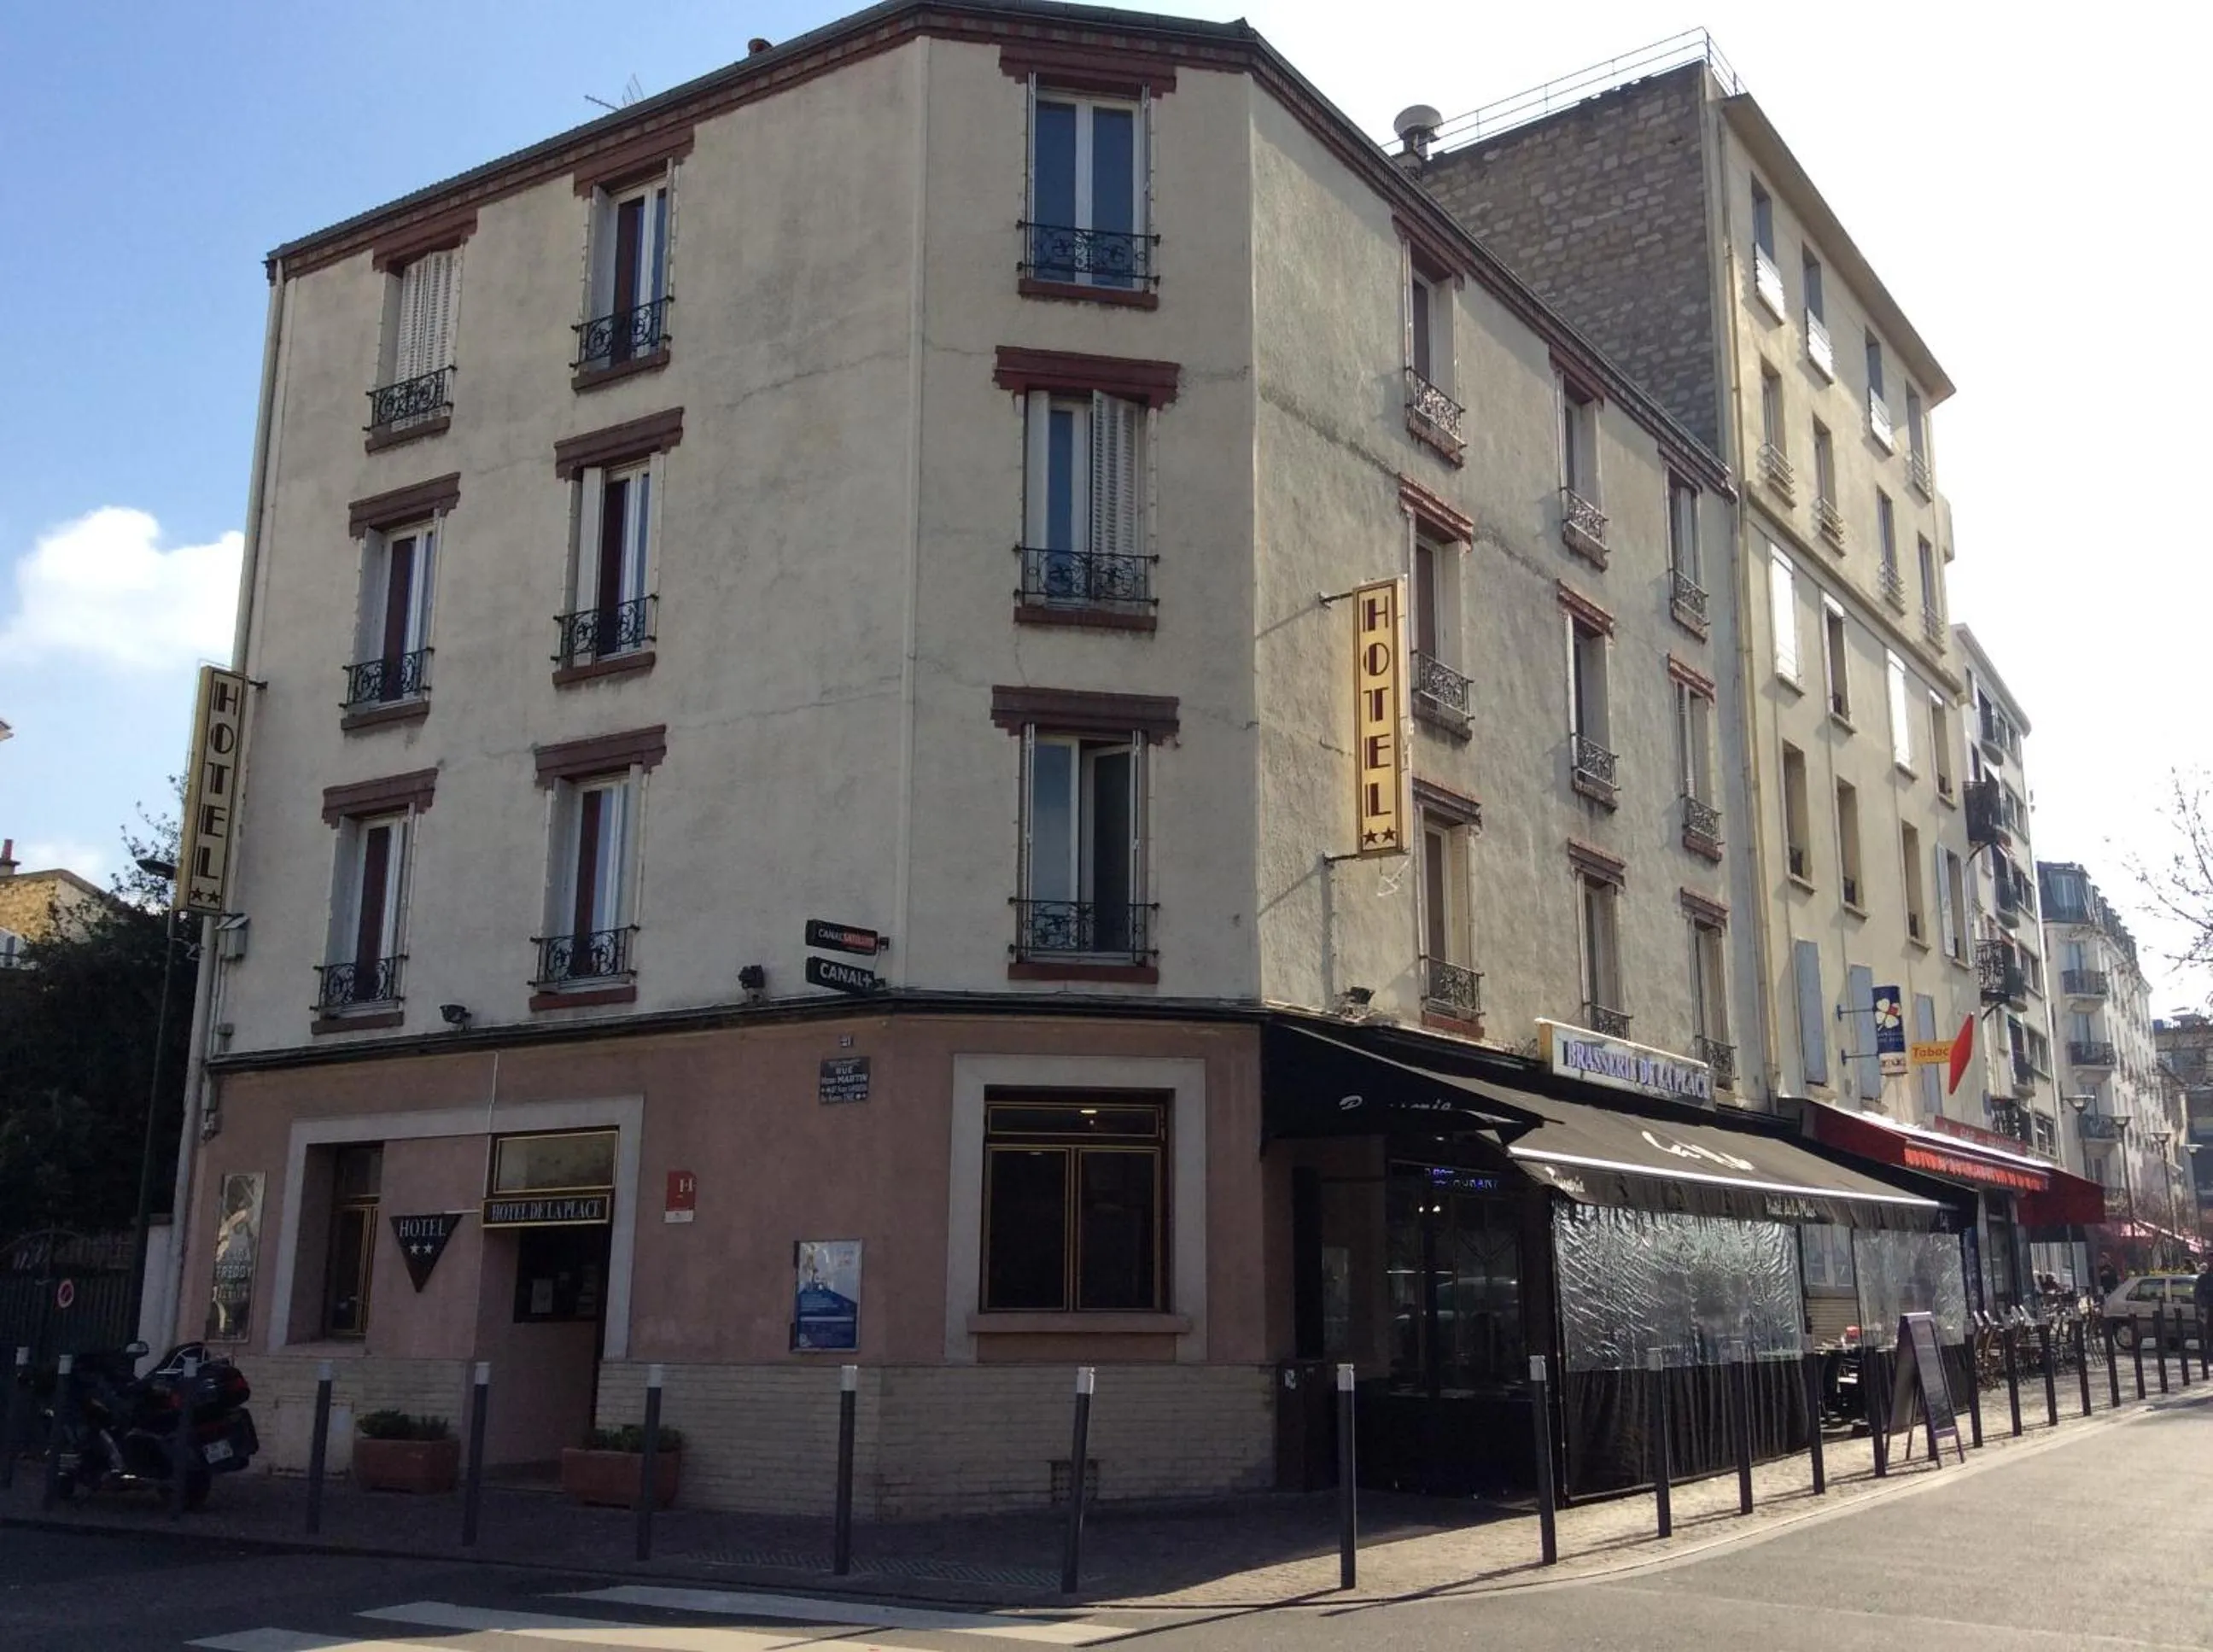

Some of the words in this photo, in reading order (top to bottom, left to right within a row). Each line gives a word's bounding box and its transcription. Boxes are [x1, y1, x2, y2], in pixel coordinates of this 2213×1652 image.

[1362, 595, 1393, 818] HOTEL
[196, 680, 239, 880] HOTEL
[820, 962, 872, 988] CANAL+
[1912, 1045, 1950, 1058] Tabac
[835, 1065, 854, 1075] RUE
[837, 1073, 868, 1084] MARTIN
[1566, 1039, 1638, 1083] BRASSERIE
[1639, 1057, 1655, 1088] DE
[1659, 1061, 1674, 1091] LA
[1673, 1065, 1711, 1100] PLACE
[492, 1202, 527, 1222] HOTEL
[529, 1201, 544, 1220] DE
[546, 1201, 563, 1220] LA
[563, 1199, 602, 1219] PLACE
[399, 1217, 447, 1238] HOTEL
